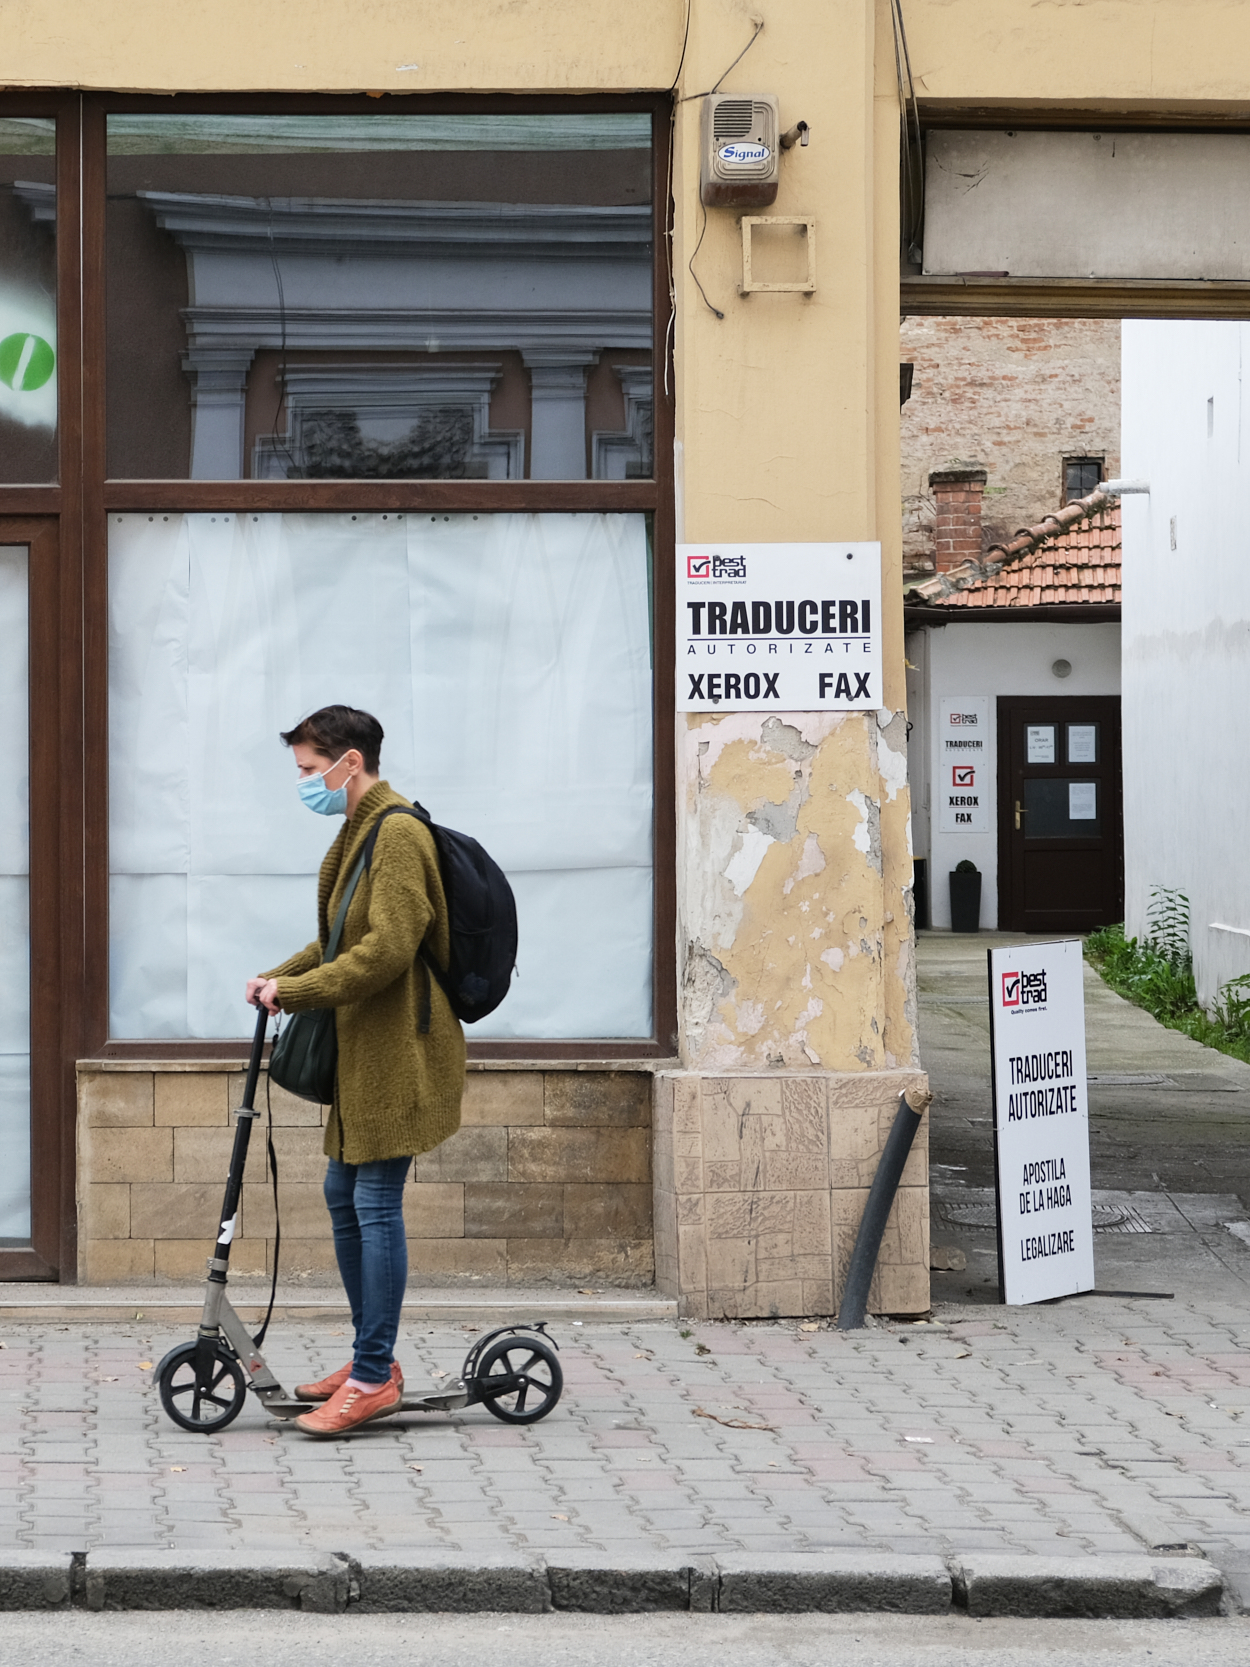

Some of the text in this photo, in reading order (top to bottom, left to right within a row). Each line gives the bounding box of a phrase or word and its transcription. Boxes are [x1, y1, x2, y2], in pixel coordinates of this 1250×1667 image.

[724, 146, 765, 161] Signal
[712, 555, 746, 567] best
[711, 565, 747, 578] trad
[687, 599, 871, 635] TRADUCERI
[687, 642, 872, 655] AUTORIZATE
[688, 672, 871, 700] XEROX FAX
[945, 740, 983, 748] TRADUCERI
[949, 796, 979, 806] XEROX
[955, 813, 972, 823] FAX
[1021, 968, 1047, 988] best
[1020, 983, 1047, 1004] trad
[1009, 1049, 1073, 1085] TRADUCERI
[1008, 1085, 1077, 1122] AUTORIZATE
[1022, 1157, 1066, 1187] APOSTILA
[1019, 1184, 1072, 1215] DE LA HAGA
[1020, 1230, 1075, 1262] LEGALIZARE
